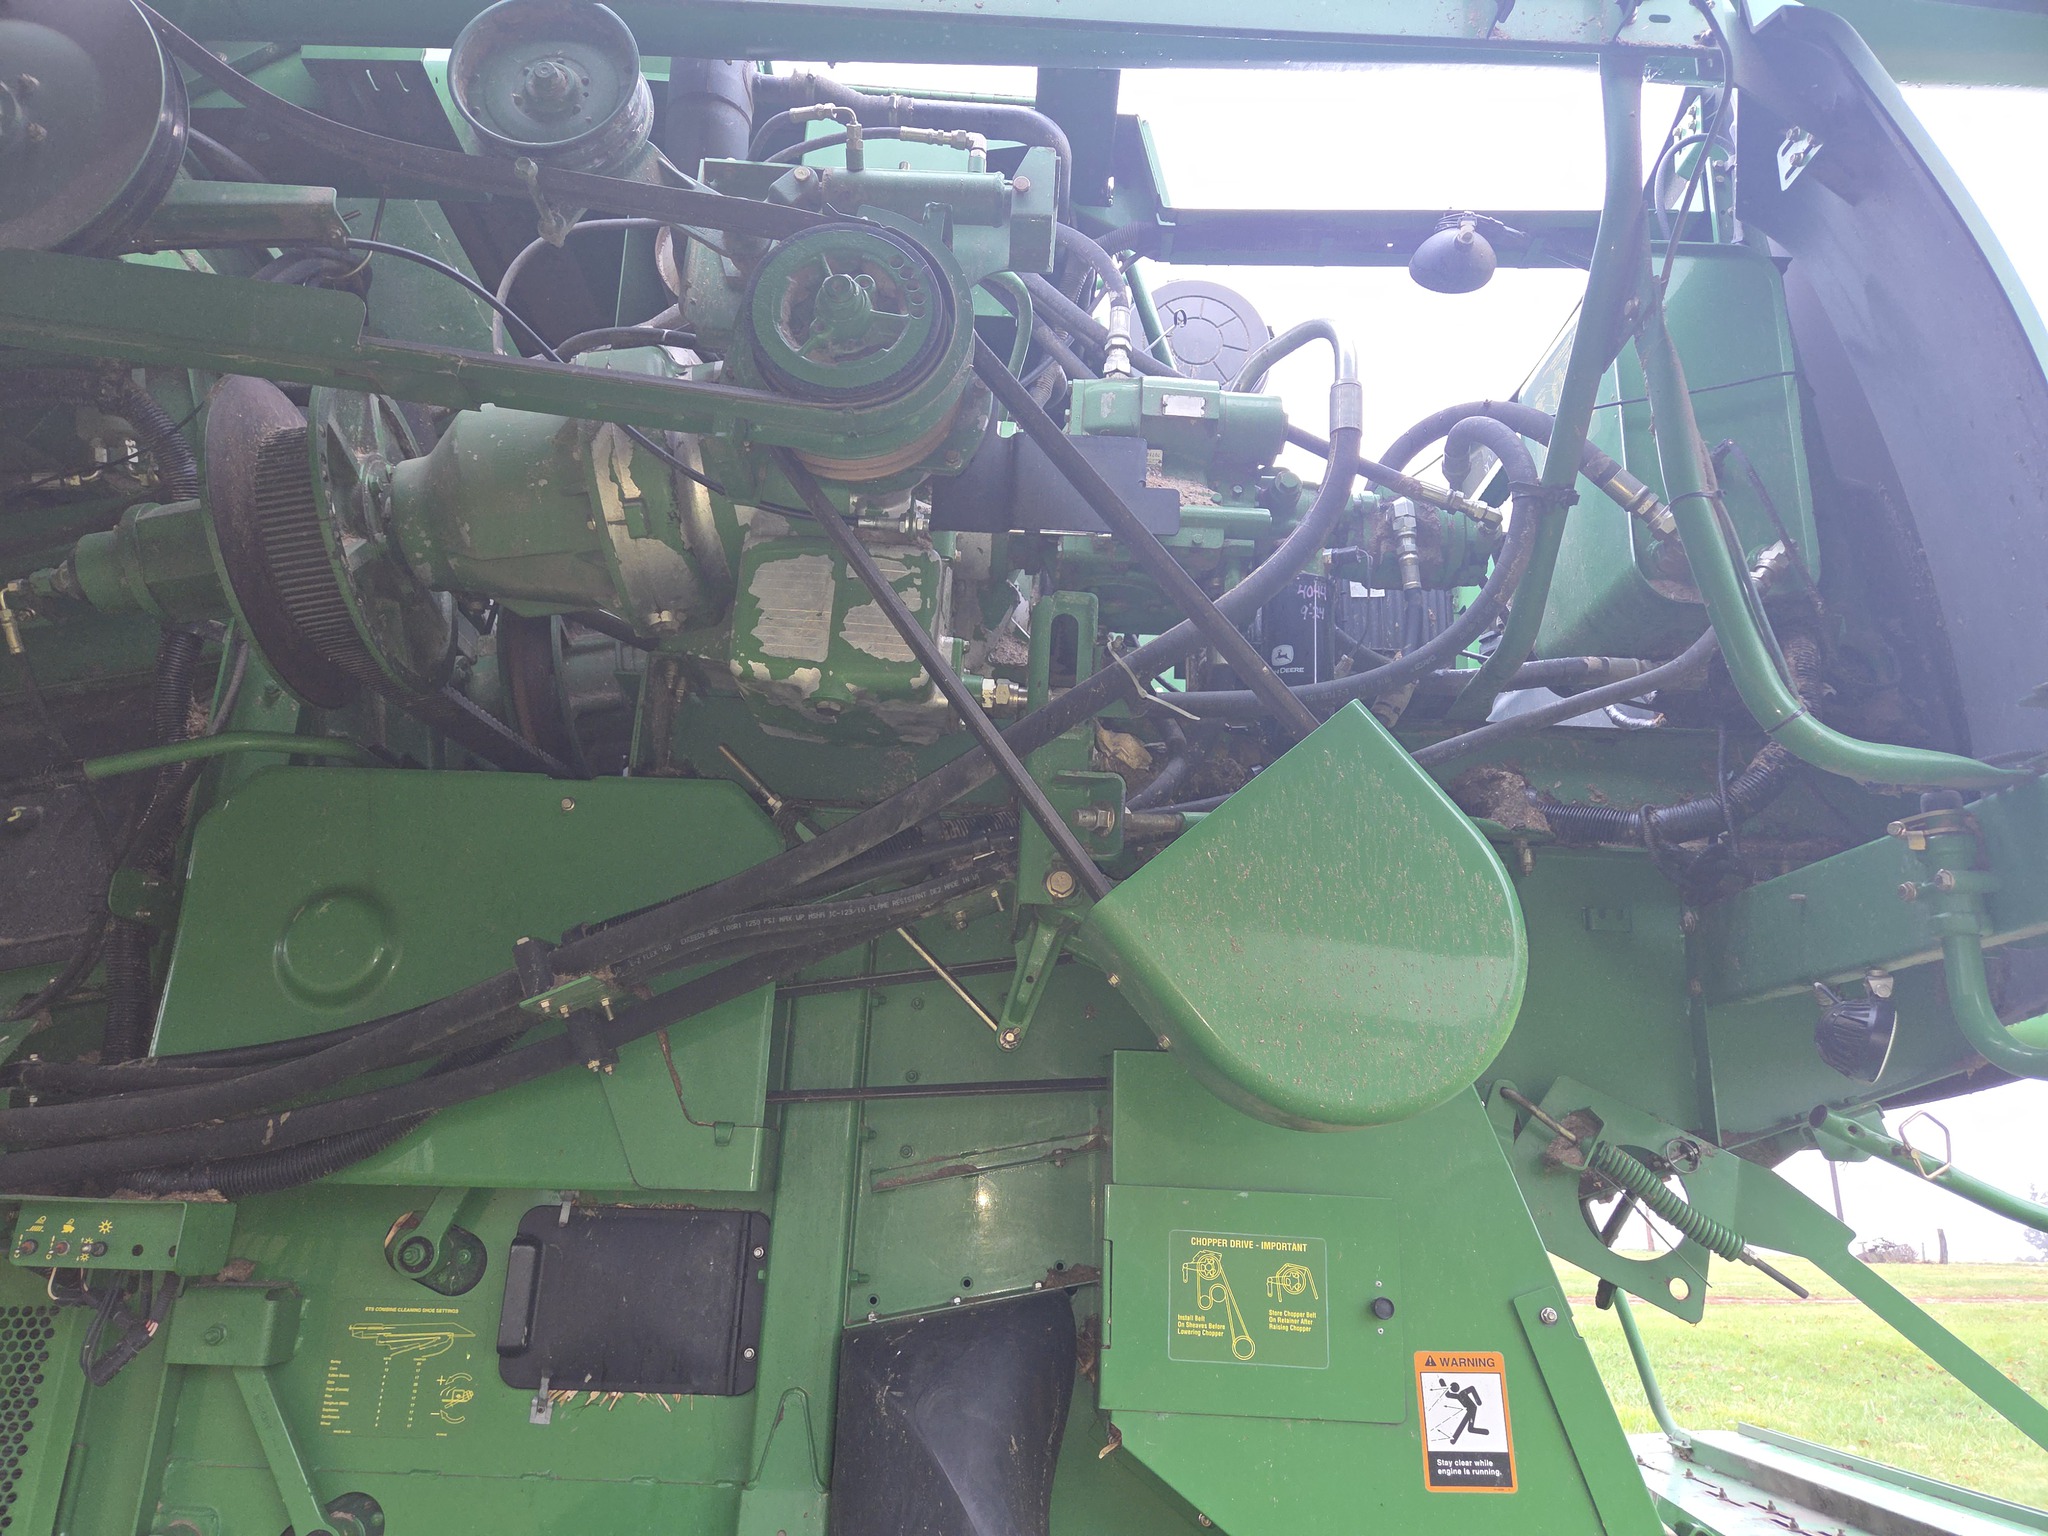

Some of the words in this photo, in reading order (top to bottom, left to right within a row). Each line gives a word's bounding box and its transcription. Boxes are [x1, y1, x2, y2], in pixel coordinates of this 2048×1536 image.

[1297, 584, 1327, 601] 4044
[763, 915, 776, 925] PSI
[869, 902, 890, 912] FLAME
[892, 891, 927, 907] RESISTANT
[944, 880, 960, 891] MADE
[1190, 1237, 1228, 1248] CHOPPER
[1230, 1239, 1254, 1249] DRIVE
[1261, 1241, 1307, 1252] IMPORTANT
[1268, 1309, 1283, 1317] Store
[1284, 1310, 1305, 1319] Chopper
[1268, 1316, 1277, 1324] On
[1277, 1317, 1300, 1325] Retainer
[1268, 1324, 1289, 1332] Raising
[1289, 1325, 1311, 1333] Chopper
[1177, 1329, 1201, 1337] Lowering
[1202, 1330, 1224, 1338] Chopper
[1439, 1357, 1495, 1368] WARNING
[1436, 1458, 1453, 1467] Stay
[1454, 1459, 1472, 1467] clear
[1437, 1468, 1462, 1476] engine
[1472, 1468, 1502, 1477] running.
